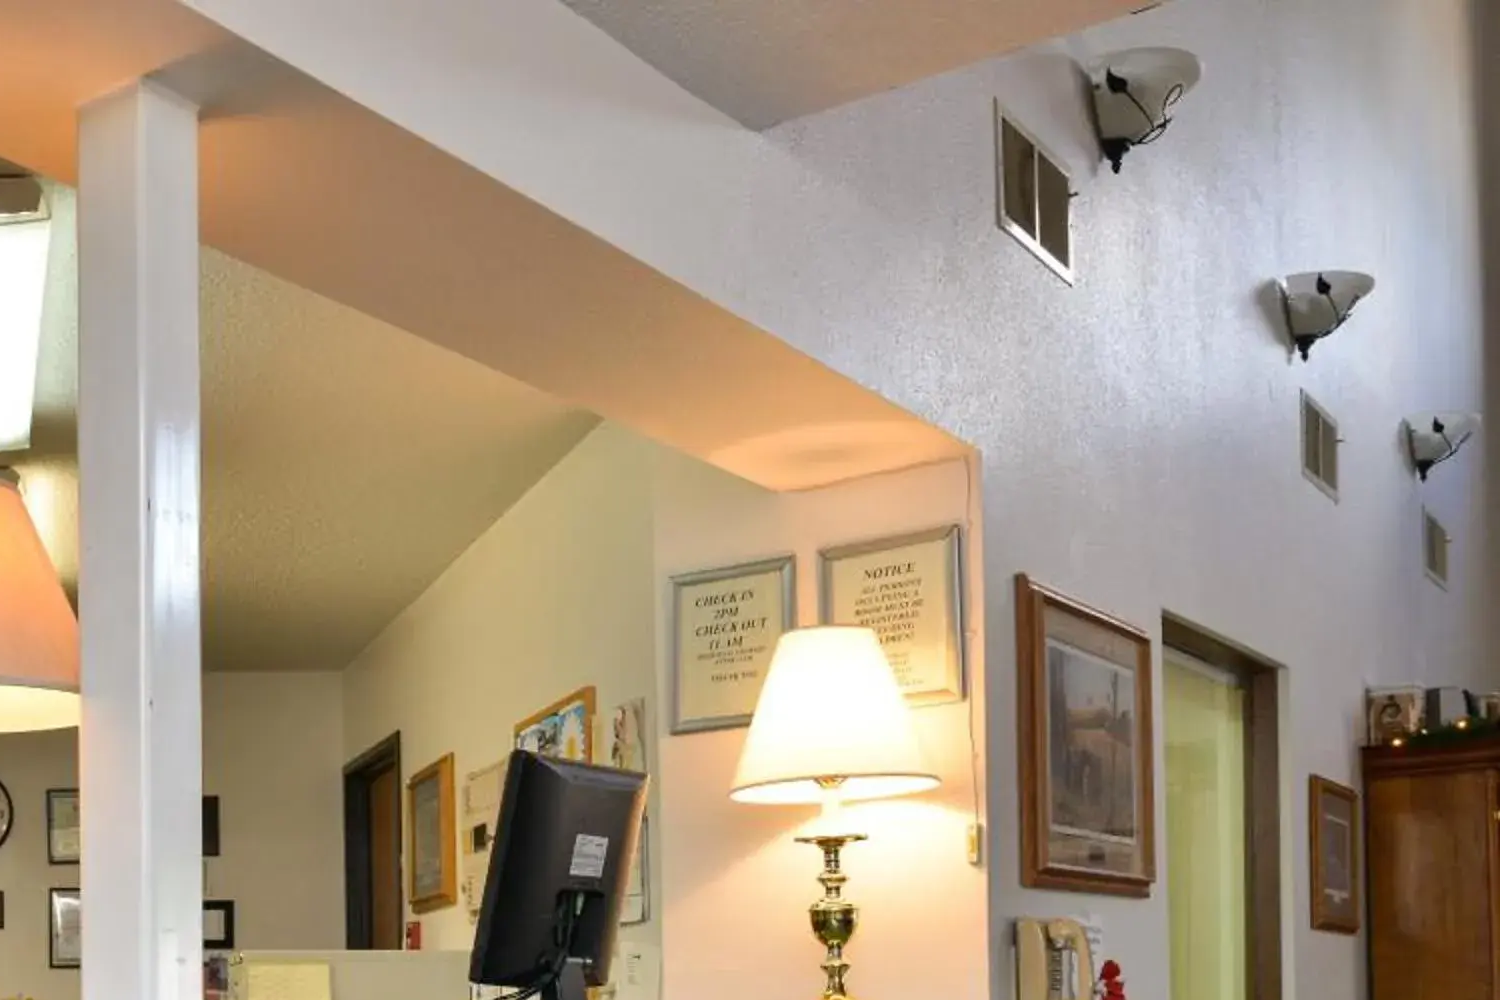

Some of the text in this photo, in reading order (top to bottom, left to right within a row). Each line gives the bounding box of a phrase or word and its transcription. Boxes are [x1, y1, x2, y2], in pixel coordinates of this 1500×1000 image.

[864, 562, 916, 579] NOTICE
[695, 590, 755, 607] CHECK IN
[695, 617, 768, 637] CHECK OUT
